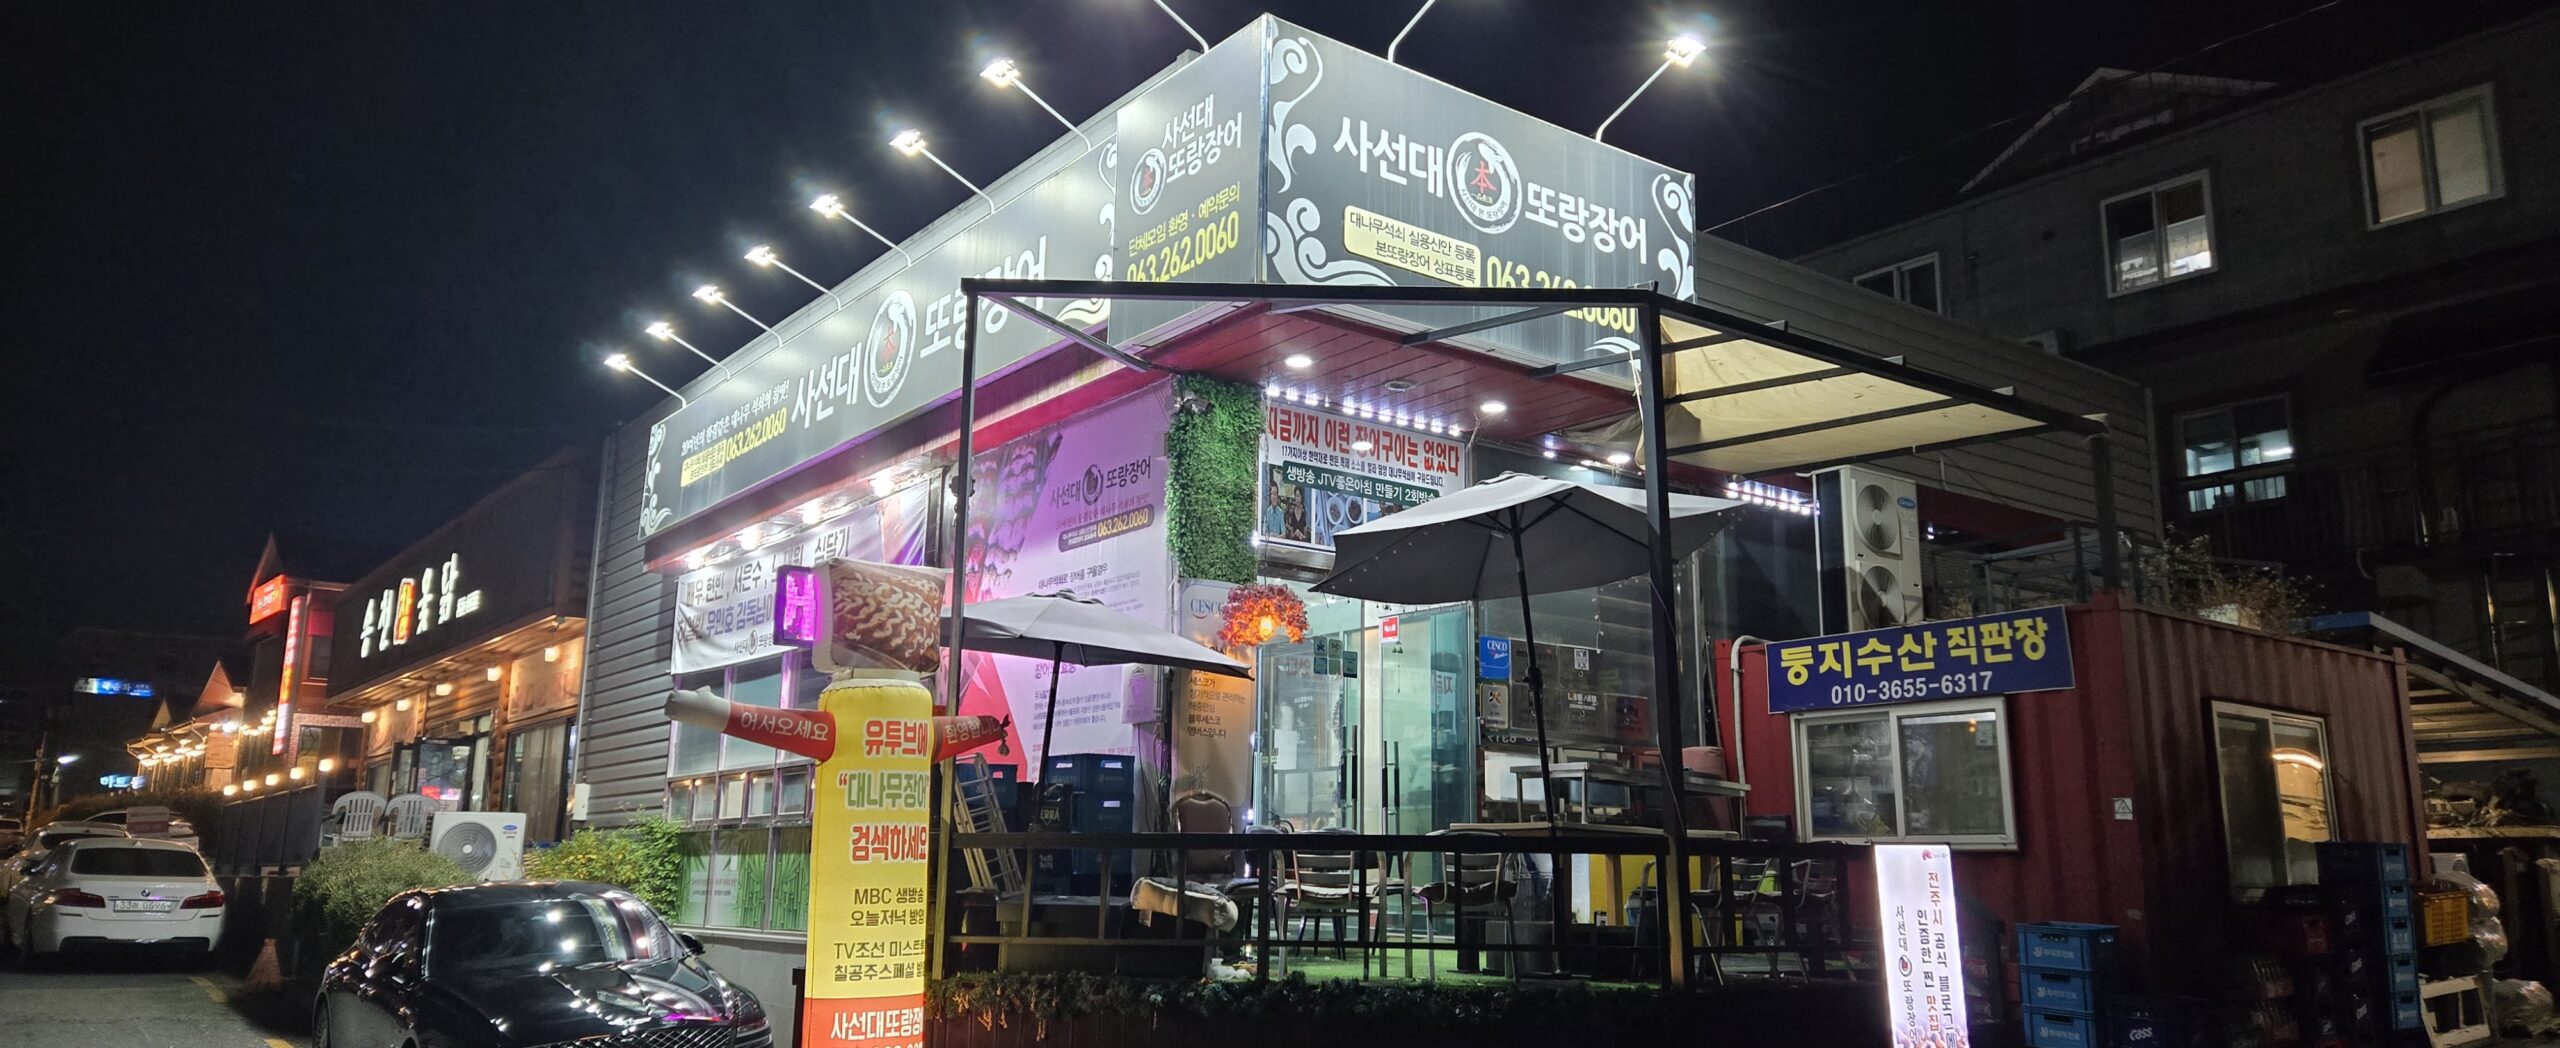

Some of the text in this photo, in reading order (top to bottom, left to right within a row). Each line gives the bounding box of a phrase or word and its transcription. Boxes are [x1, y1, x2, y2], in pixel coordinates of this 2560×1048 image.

[1161, 94, 1214, 149] 사선대
[1166, 112, 1242, 184] 또랑장어
[1332, 116, 1647, 265] 사선대 또랑장어
[1128, 181, 1241, 257] 단체모임 환영 예약문의
[1350, 211, 1476, 264] 대나무석쇠 실용신안 등록
[1126, 210, 1239, 282] 063.262.0060
[1375, 240, 1476, 285] 본또랑장어 상표등록
[1486, 255, 1636, 334] 063.0060
[791, 341, 863, 429] 사선대
[725, 406, 787, 463] 063.262.0060
[1266, 406, 1460, 477] 지금까지 이런 장어구이는 없었다
[1050, 455, 1151, 509] 사선대 또랑장어
[1286, 465, 1316, 485] 생방송
[1317, 472, 1373, 496] JTV좋은아침
[1375, 482, 1402, 501] 만들기
[1097, 508, 1149, 538] 063.262.0060
[1486, 639, 1508, 652] CESCO
[1780, 616, 2049, 686] 둥지수산 직판장
[1831, 670, 1994, 705] 010-3655-6317
[740, 711, 829, 742] 어서오세요
[865, 720, 928, 757] 유투브에
[851, 824, 927, 861] 검색하세요
[850, 909, 907, 927] 오늘저녁
[854, 887, 924, 905] MBC 생방송
[1927, 871, 1944, 926] 전주시
[833, 941, 885, 960] TV조선
[834, 961, 915, 982] 칠공주스페셜
[1895, 904, 1919, 1042] 사선대 또랑장어
[1917, 909, 1940, 1032] 인증한 찐 맛집
[1934, 932, 1949, 968] 공식
